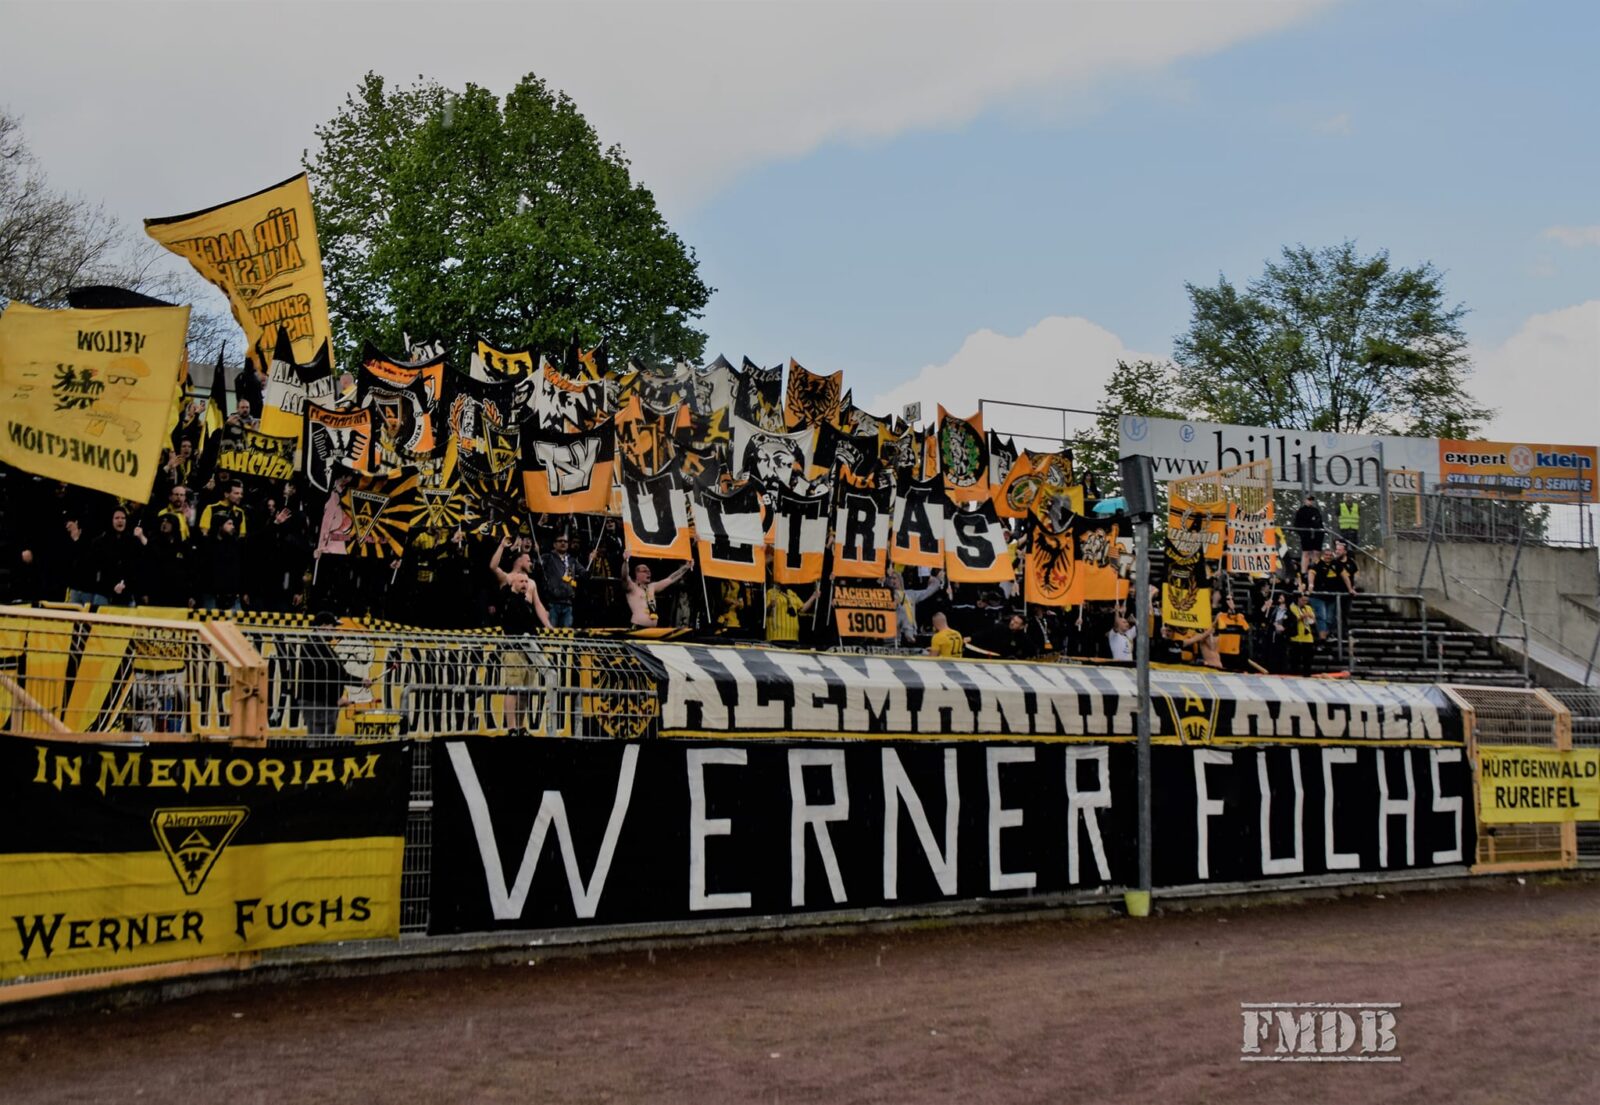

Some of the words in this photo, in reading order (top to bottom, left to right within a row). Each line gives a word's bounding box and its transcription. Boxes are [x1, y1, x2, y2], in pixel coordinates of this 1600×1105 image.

[1445, 453, 1506, 466] expert
[1537, 452, 1592, 468] klein
[1534, 477, 1543, 489] &
[1232, 553, 1270, 571] ULTRAS
[847, 611, 886, 634] 1900
[646, 645, 1161, 735] ALEMANNIA
[1226, 674, 1444, 739] AACHEN
[96, 751, 381, 797] MEMORIAM
[1495, 786, 1580, 808] RUREIFEL
[163, 812, 238, 829] Alemannia
[445, 741, 1112, 921] WERNER
[1193, 747, 1464, 880] FUCHS
[13, 910, 205, 961] WERNER
[234, 896, 372, 942] FUCHS
